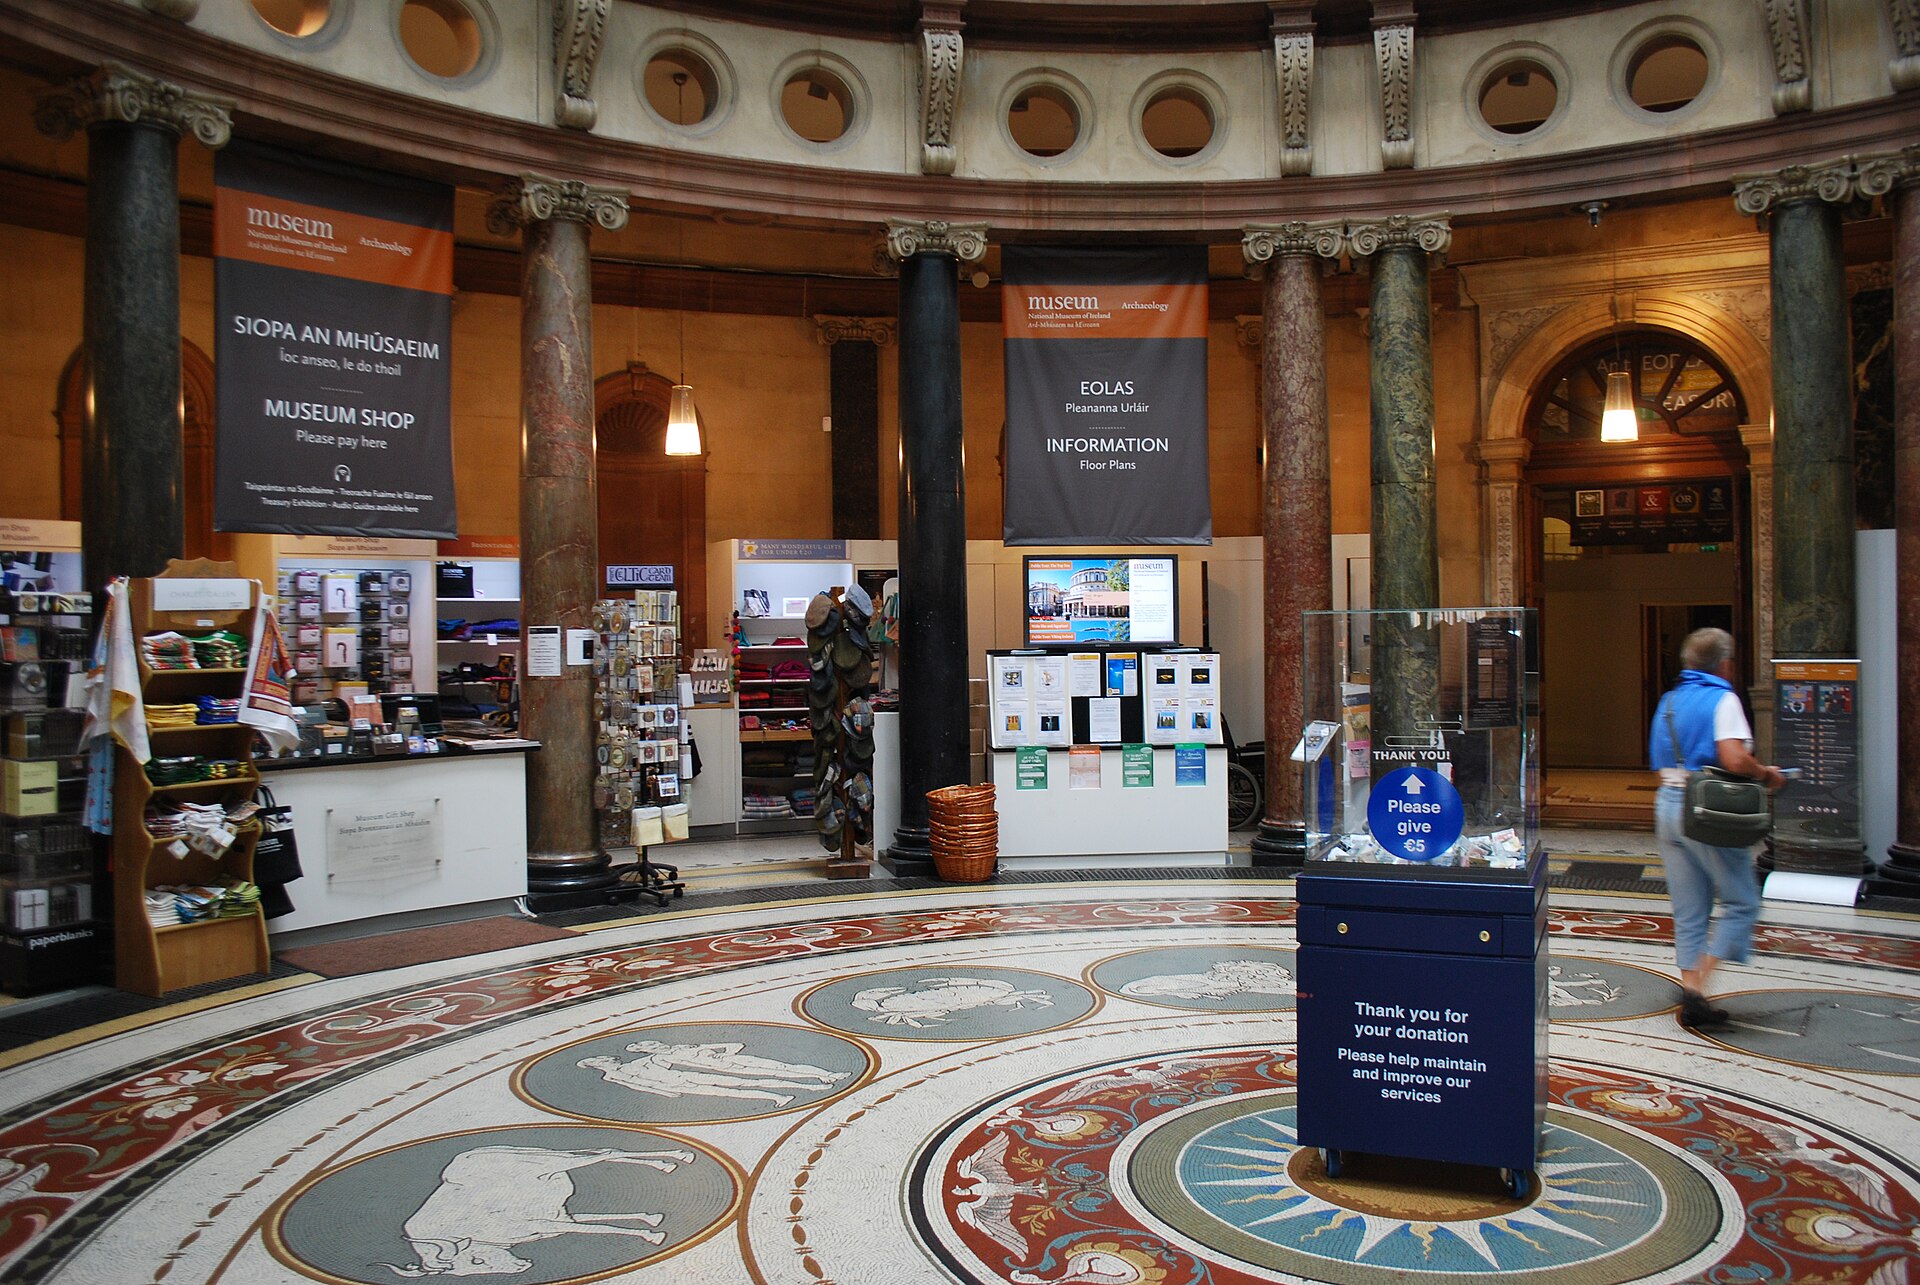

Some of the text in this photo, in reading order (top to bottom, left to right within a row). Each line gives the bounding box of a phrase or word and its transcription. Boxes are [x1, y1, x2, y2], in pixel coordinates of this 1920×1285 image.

[247, 207, 333, 239] museum
[247, 228, 281, 241] National
[281, 234, 313, 247] Museum
[320, 241, 347, 254] Ireland
[359, 235, 413, 257] Archaeology
[1028, 296, 1098, 310] museum
[1121, 301, 1169, 312] Archaeology
[234, 315, 440, 360] SIOPA AN MHÚSAEIM
[279, 347, 402, 376] Íoc anseo, le do thoil
[1080, 381, 1134, 396] EOLAS
[265, 399, 415, 430] MUSEUM SHOP
[1065, 402, 1149, 413] Pleananna Urláir
[296, 429, 388, 450] Please pay here
[1047, 437, 1169, 453] INFORMATION
[1080, 460, 1136, 470] Floor Plans
[261, 497, 291, 508] Treasury
[292, 499, 327, 508] Exhibition
[332, 500, 352, 509] Audio
[352, 502, 376, 511] Guides
[376, 503, 404, 512] available
[404, 505, 419, 513] here
[1645, 494, 1660, 507] &
[1134, 562, 1164, 570] museum
[1373, 750, 1450, 760] THANK YOU!
[1388, 799, 1441, 814] Please
[1397, 820, 1432, 836] give
[1403, 839, 1425, 852] €5
[29, 928, 94, 950] paperblanks
[1354, 1001, 1469, 1024] Thank you for
[1354, 1023, 1469, 1044] your donation
[1337, 1047, 1487, 1073] Please help maintain
[1352, 1067, 1472, 1089] and improve our
[1380, 1087, 1442, 1103] services
